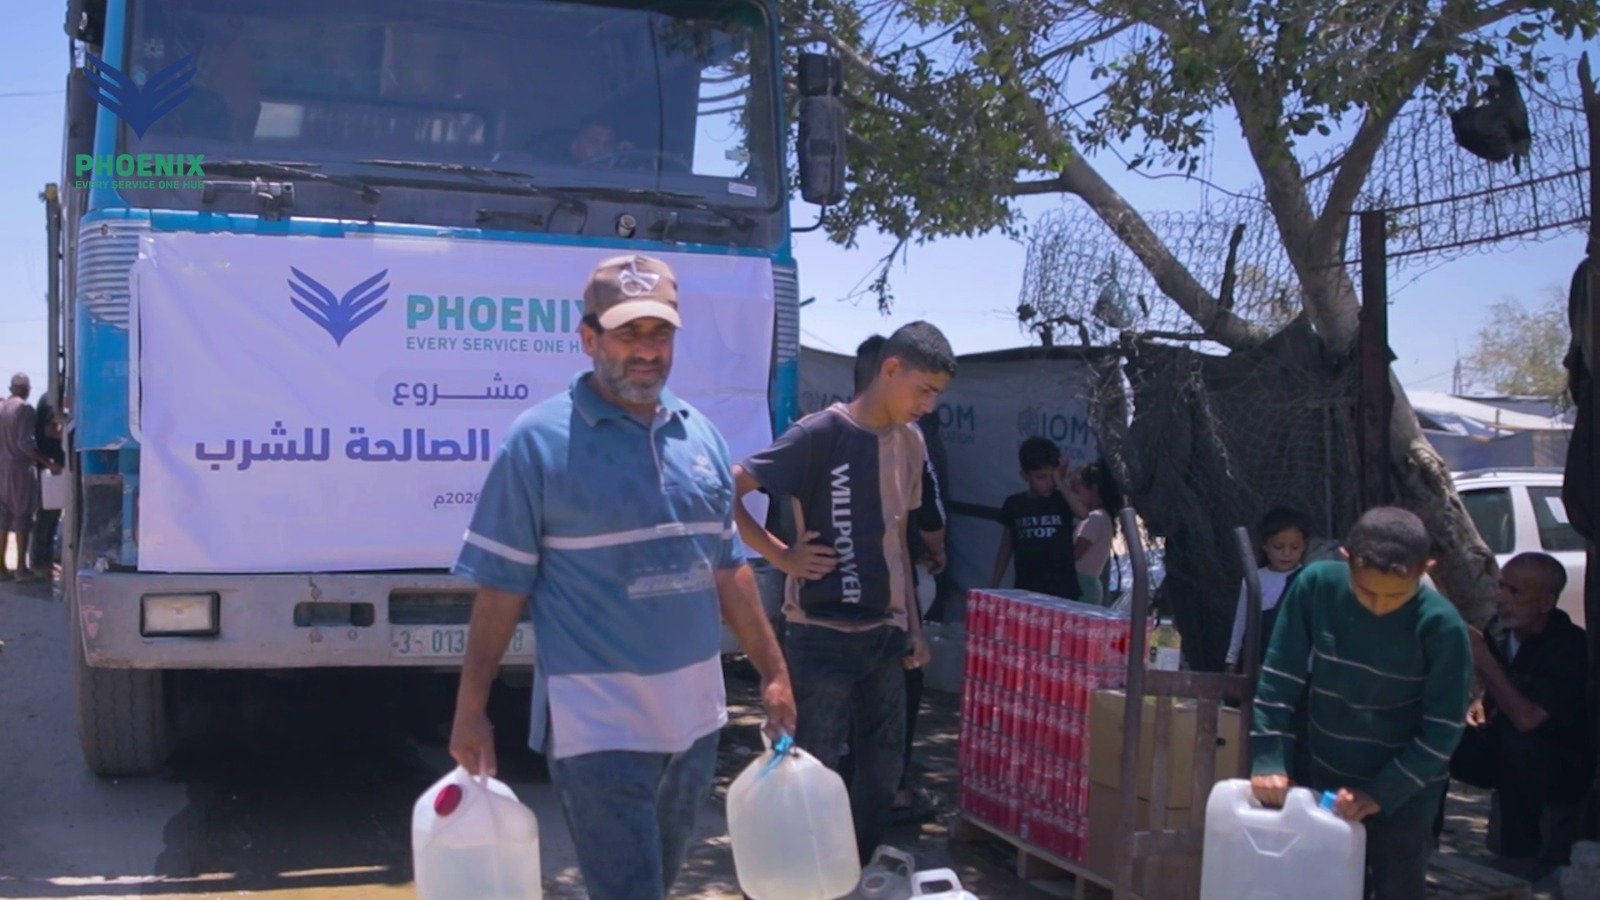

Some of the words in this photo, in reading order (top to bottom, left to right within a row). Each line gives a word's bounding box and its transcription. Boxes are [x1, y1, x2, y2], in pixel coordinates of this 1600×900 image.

[406, 337, 457, 350] EVERY
[463, 338, 528, 352] SERVICE
[533, 339, 564, 353] ONE
[392, 372, 529, 406] مشروع
[936, 402, 975, 431] OM
[1041, 411, 1089, 445] IOM
[195, 420, 330, 471] للشرب
[344, 426, 490, 462] الصالحة
[830, 462, 862, 604] WILLPOWER
[1014, 514, 1063, 528] NEVER
